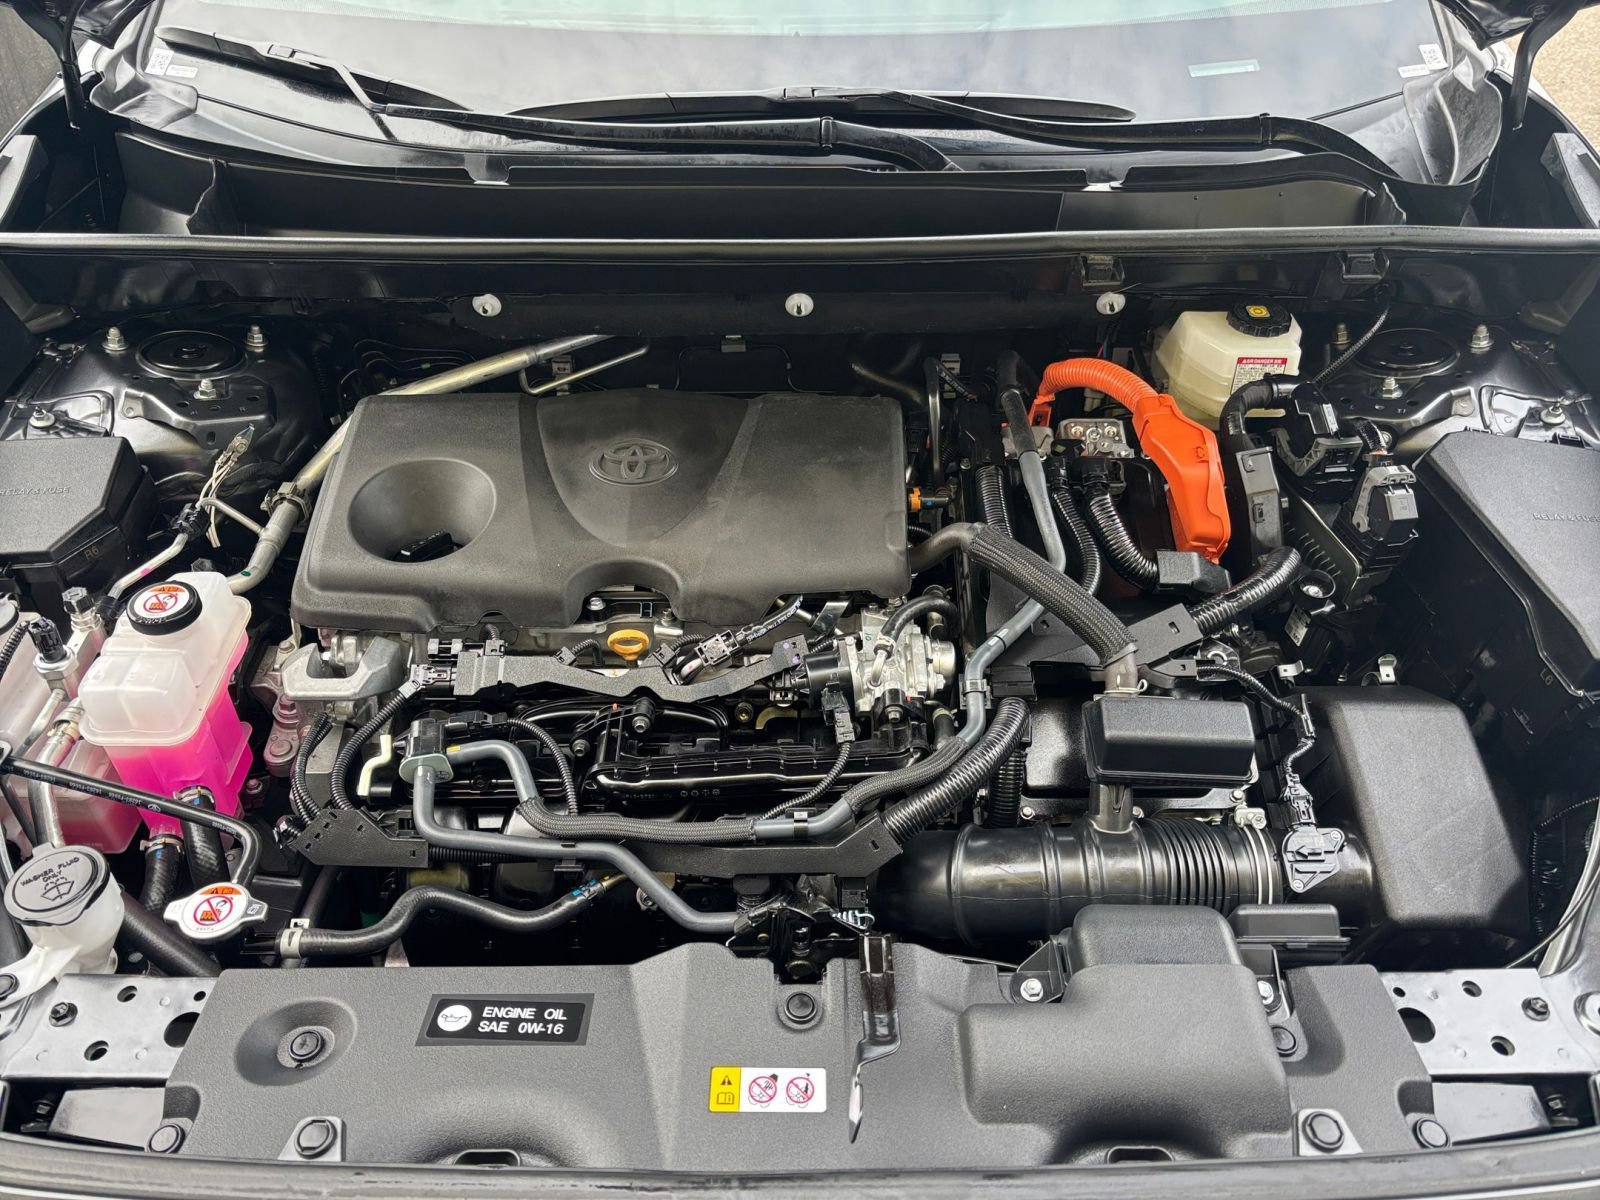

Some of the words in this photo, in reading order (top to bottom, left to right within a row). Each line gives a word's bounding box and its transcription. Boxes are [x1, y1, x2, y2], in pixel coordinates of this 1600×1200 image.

[20, 868, 54, 887] WASHER
[57, 856, 80, 869] FLUID
[42, 870, 62, 882] ONLY
[482, 1006, 536, 1019] ENGINE
[544, 1008, 568, 1020] OIL
[478, 1021, 509, 1033] SAE
[518, 1022, 564, 1035] 0W-16
